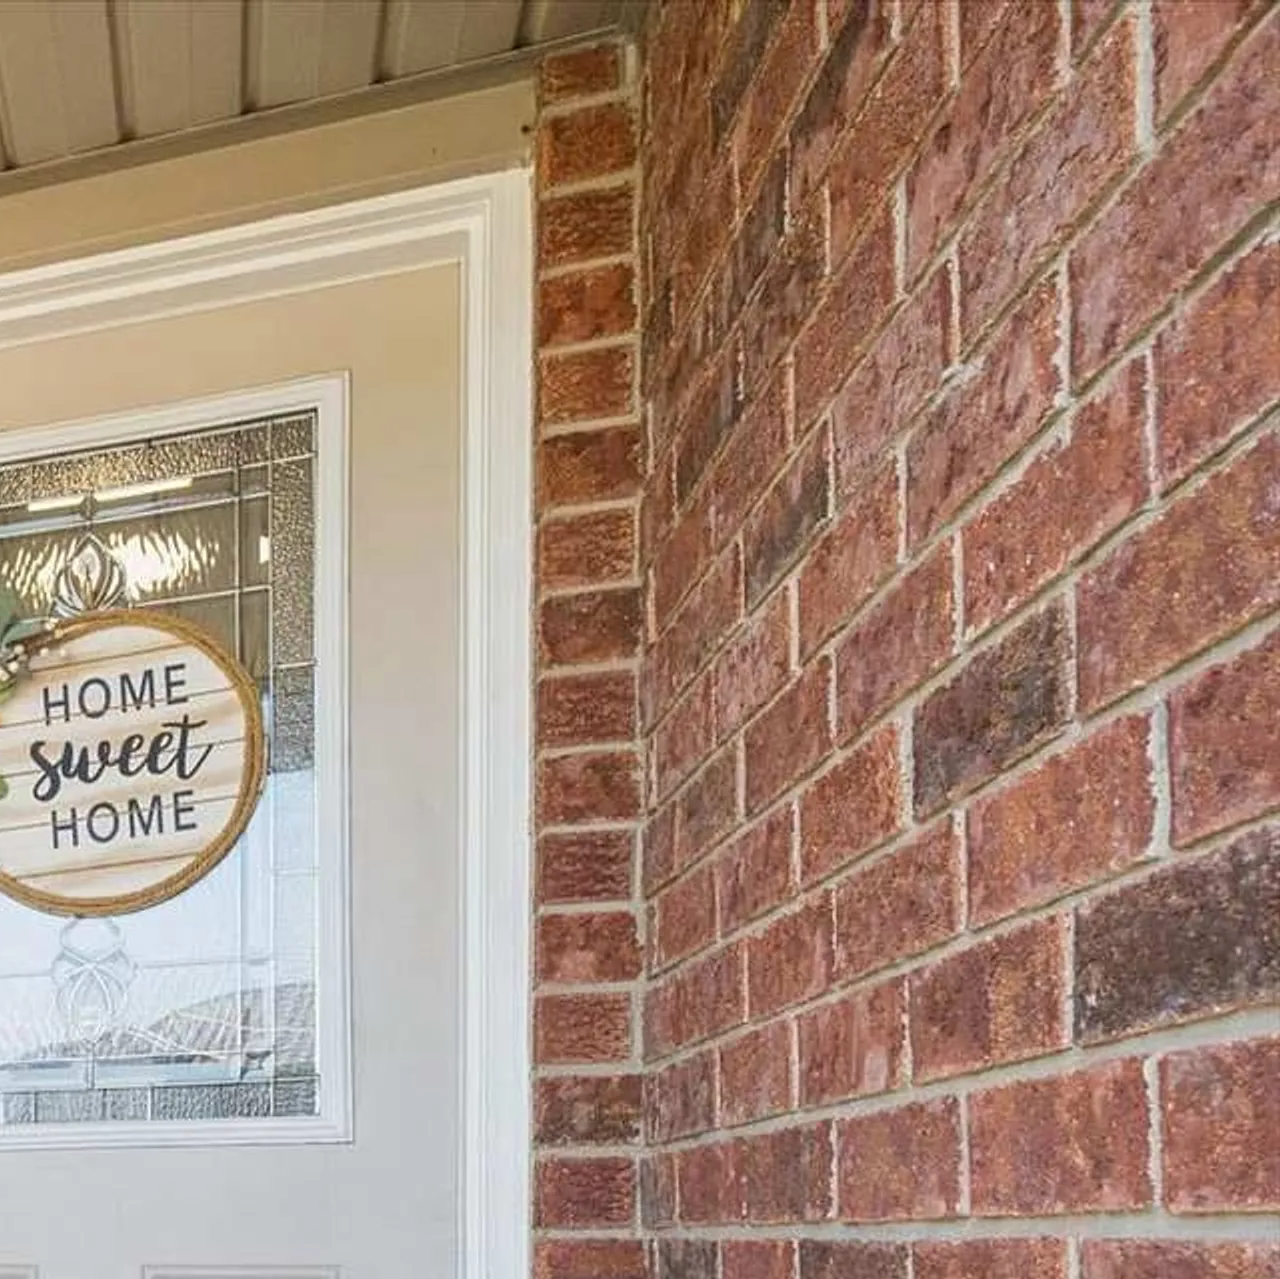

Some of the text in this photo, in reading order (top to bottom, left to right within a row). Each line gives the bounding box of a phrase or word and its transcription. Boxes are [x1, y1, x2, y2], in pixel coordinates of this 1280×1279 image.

[42, 663, 189, 725] HOME
[29, 714, 214, 801] sweet
[50, 790, 198, 849] HOME
